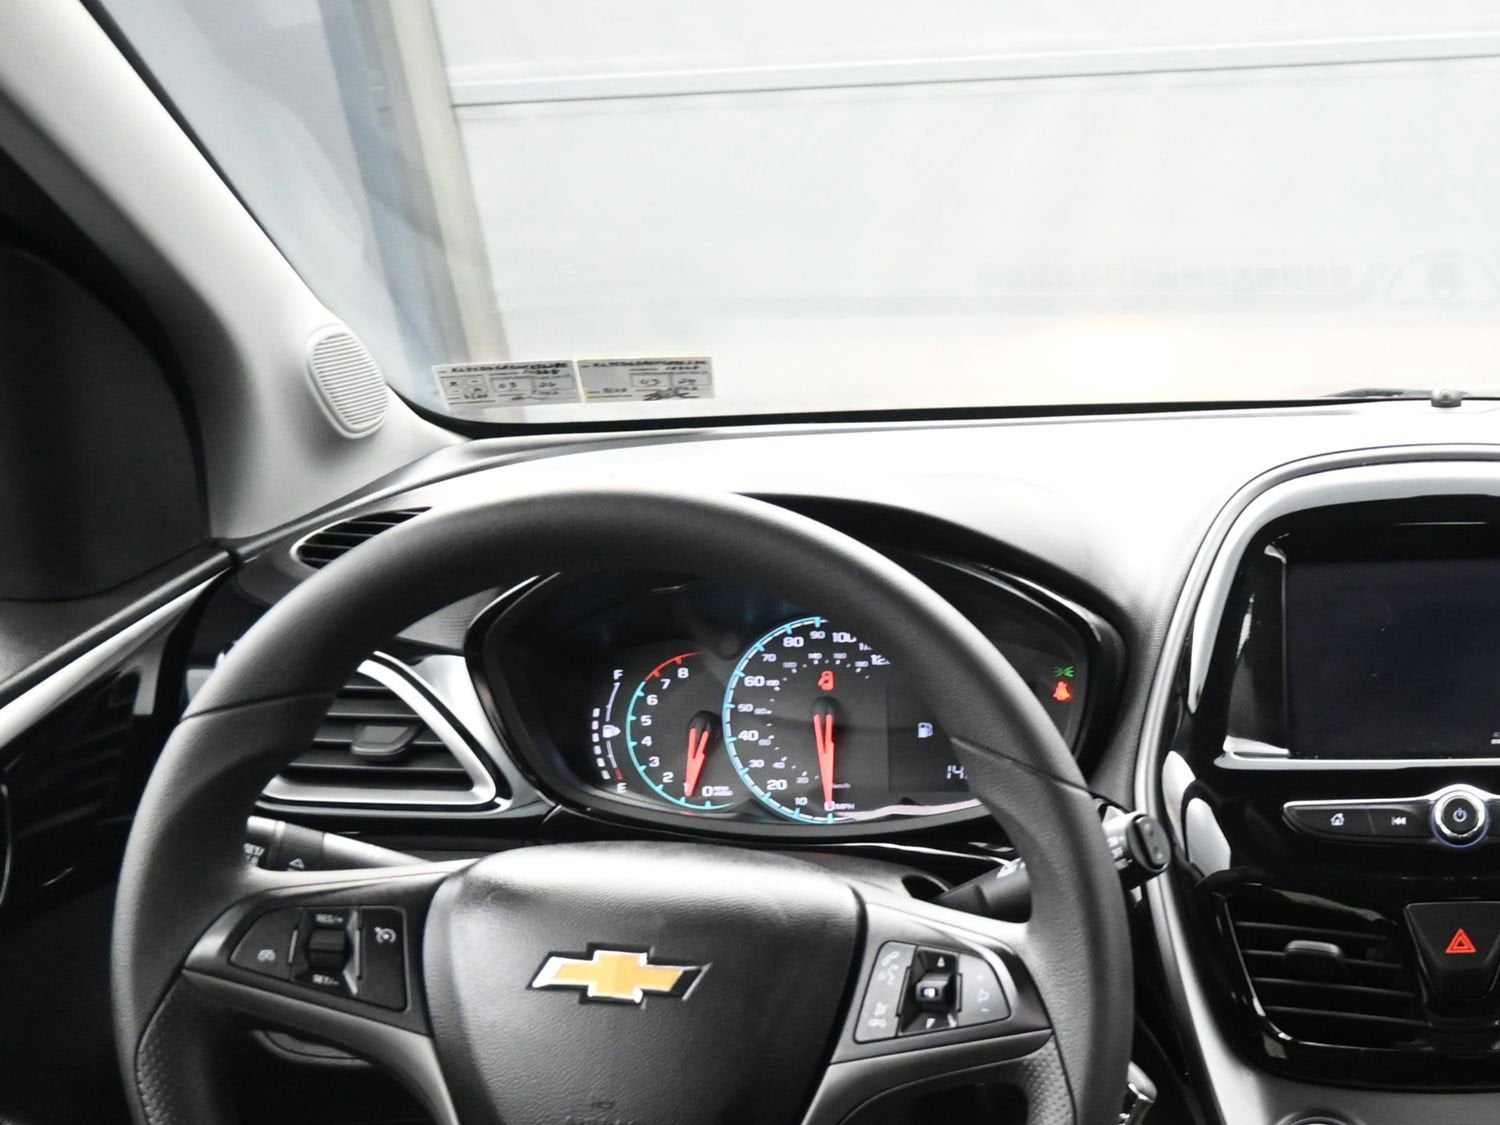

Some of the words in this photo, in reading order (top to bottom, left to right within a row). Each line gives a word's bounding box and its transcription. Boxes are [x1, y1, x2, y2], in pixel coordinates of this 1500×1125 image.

[810, 631, 825, 639] 90
[782, 636, 804, 648] 80
[762, 653, 776, 662] 70
[613, 669, 623, 680] F
[677, 667, 689, 679] 8
[660, 679, 671, 689] 7
[744, 676, 765, 687] 60
[646, 695, 658, 705] 6
[738, 704, 753, 712] 50
[640, 715, 652, 726] 5
[641, 736, 653, 746] 4
[737, 730, 758, 741] 40
[648, 756, 660, 767] 3
[748, 759, 764, 768] 30
[662, 772, 674, 783] 2
[616, 783, 627, 794] E
[766, 779, 787, 790] 20
[702, 786, 713, 797] 0
[795, 797, 808, 806] 10
